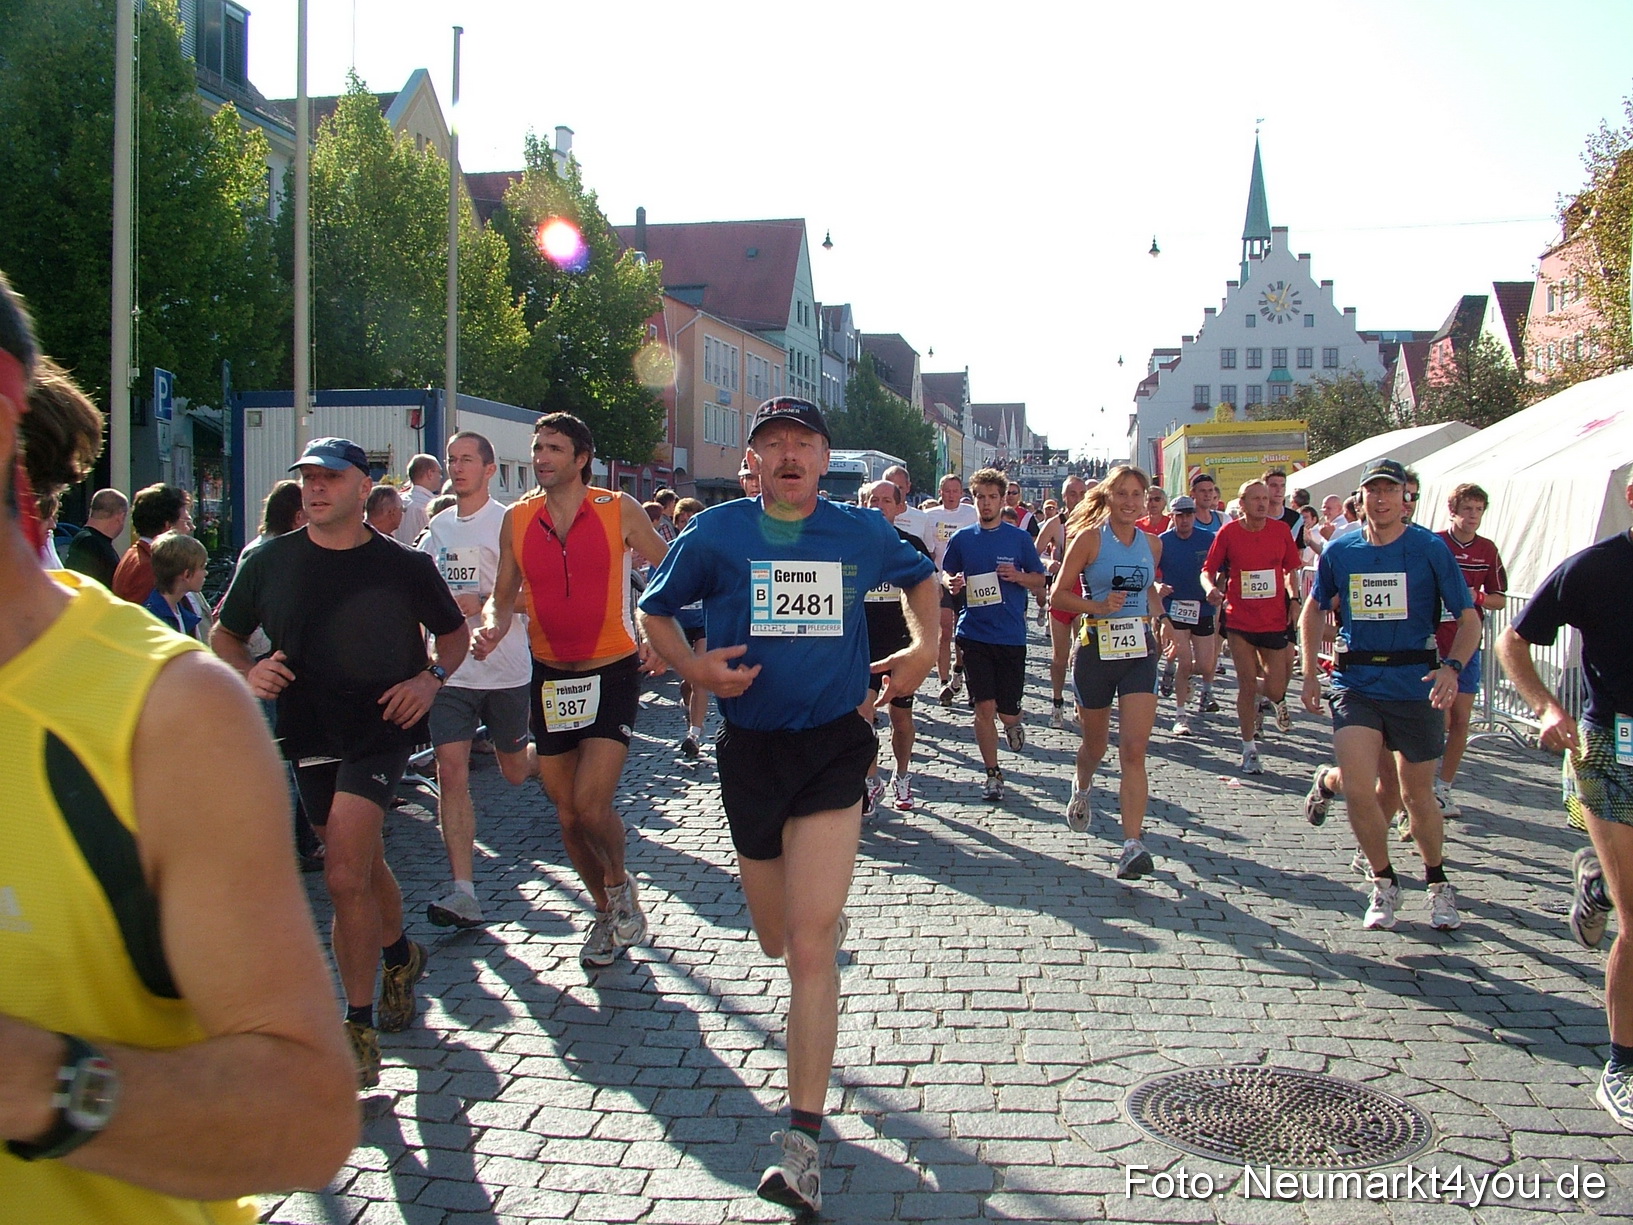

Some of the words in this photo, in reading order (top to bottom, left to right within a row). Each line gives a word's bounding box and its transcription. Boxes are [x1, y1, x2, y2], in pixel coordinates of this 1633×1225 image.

[159, 376, 168, 412] P
[447, 567, 476, 580] 2087
[774, 569, 817, 583] Gernot
[1250, 581, 1269, 592] 820
[1362, 578, 1398, 587] Clemens
[756, 589, 766, 601] B
[973, 586, 998, 598] 1082
[1352, 591, 1359, 599] B
[776, 593, 834, 615] 2481
[1364, 593, 1392, 608] 841
[1177, 608, 1198, 618] 2976
[807, 624, 842, 632] PFLEIDERER
[1110, 622, 1135, 632] Kerstin
[1112, 635, 1137, 648] 743
[556, 682, 592, 695] reinhard
[545, 700, 553, 709] B
[558, 699, 587, 717] 387
[1620, 727, 1629, 737] B
